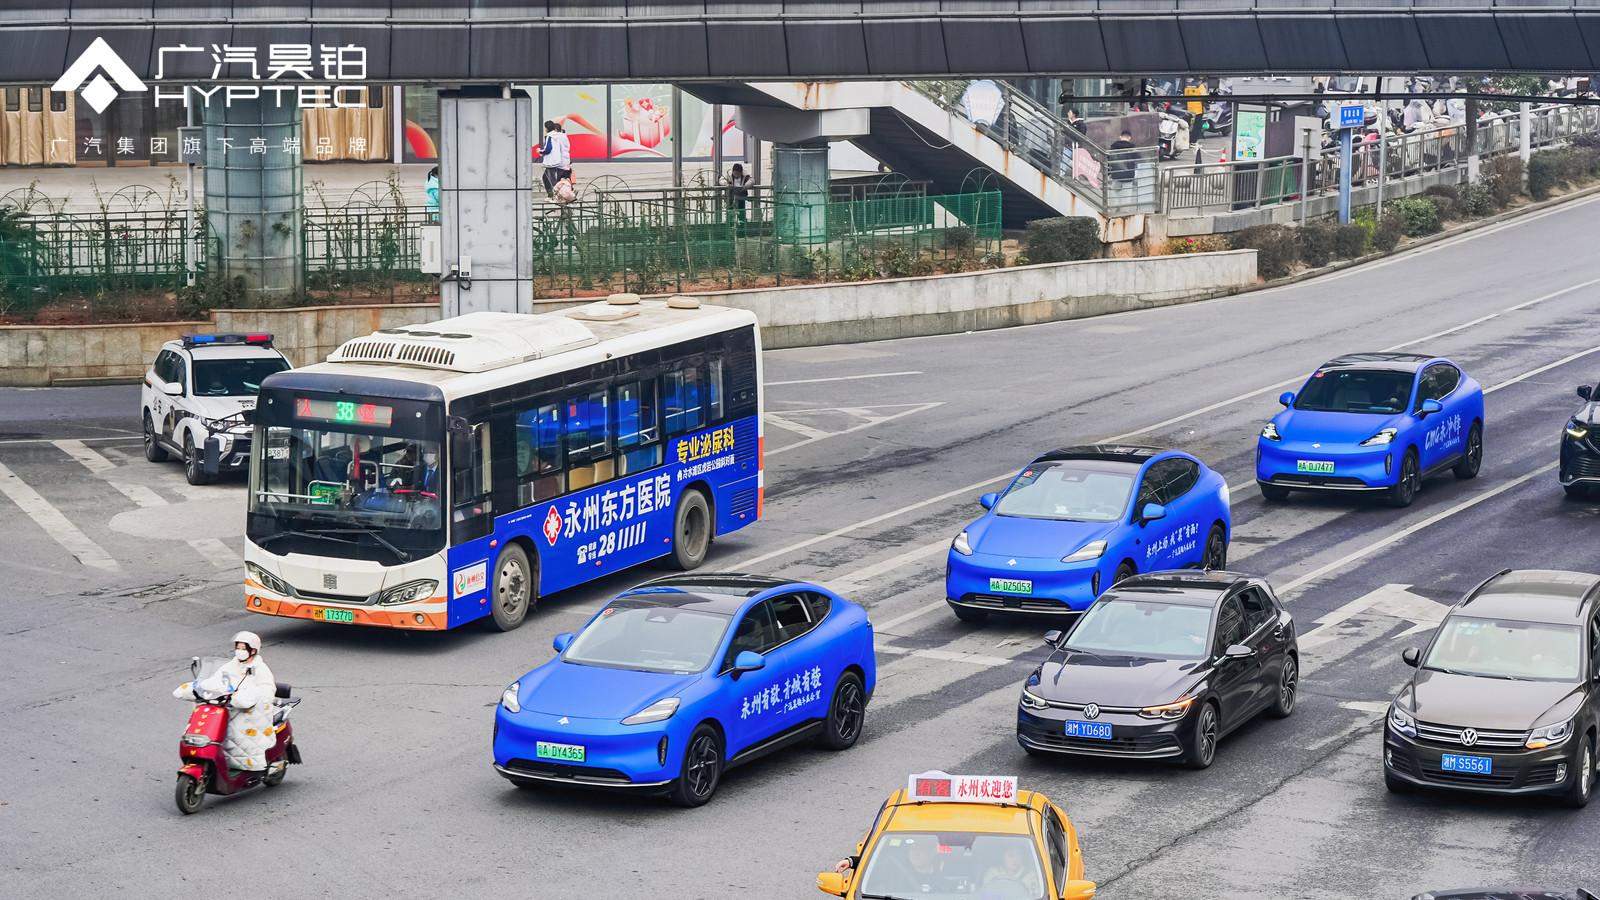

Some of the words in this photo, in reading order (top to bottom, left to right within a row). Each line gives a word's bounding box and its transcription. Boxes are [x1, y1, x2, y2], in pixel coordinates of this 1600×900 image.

[336, 401, 354, 421] 38
[677, 425, 734, 464] 专业泌尿科
[564, 472, 671, 538] 永州东方医院
[957, 779, 1013, 799] 永州欢迎您
